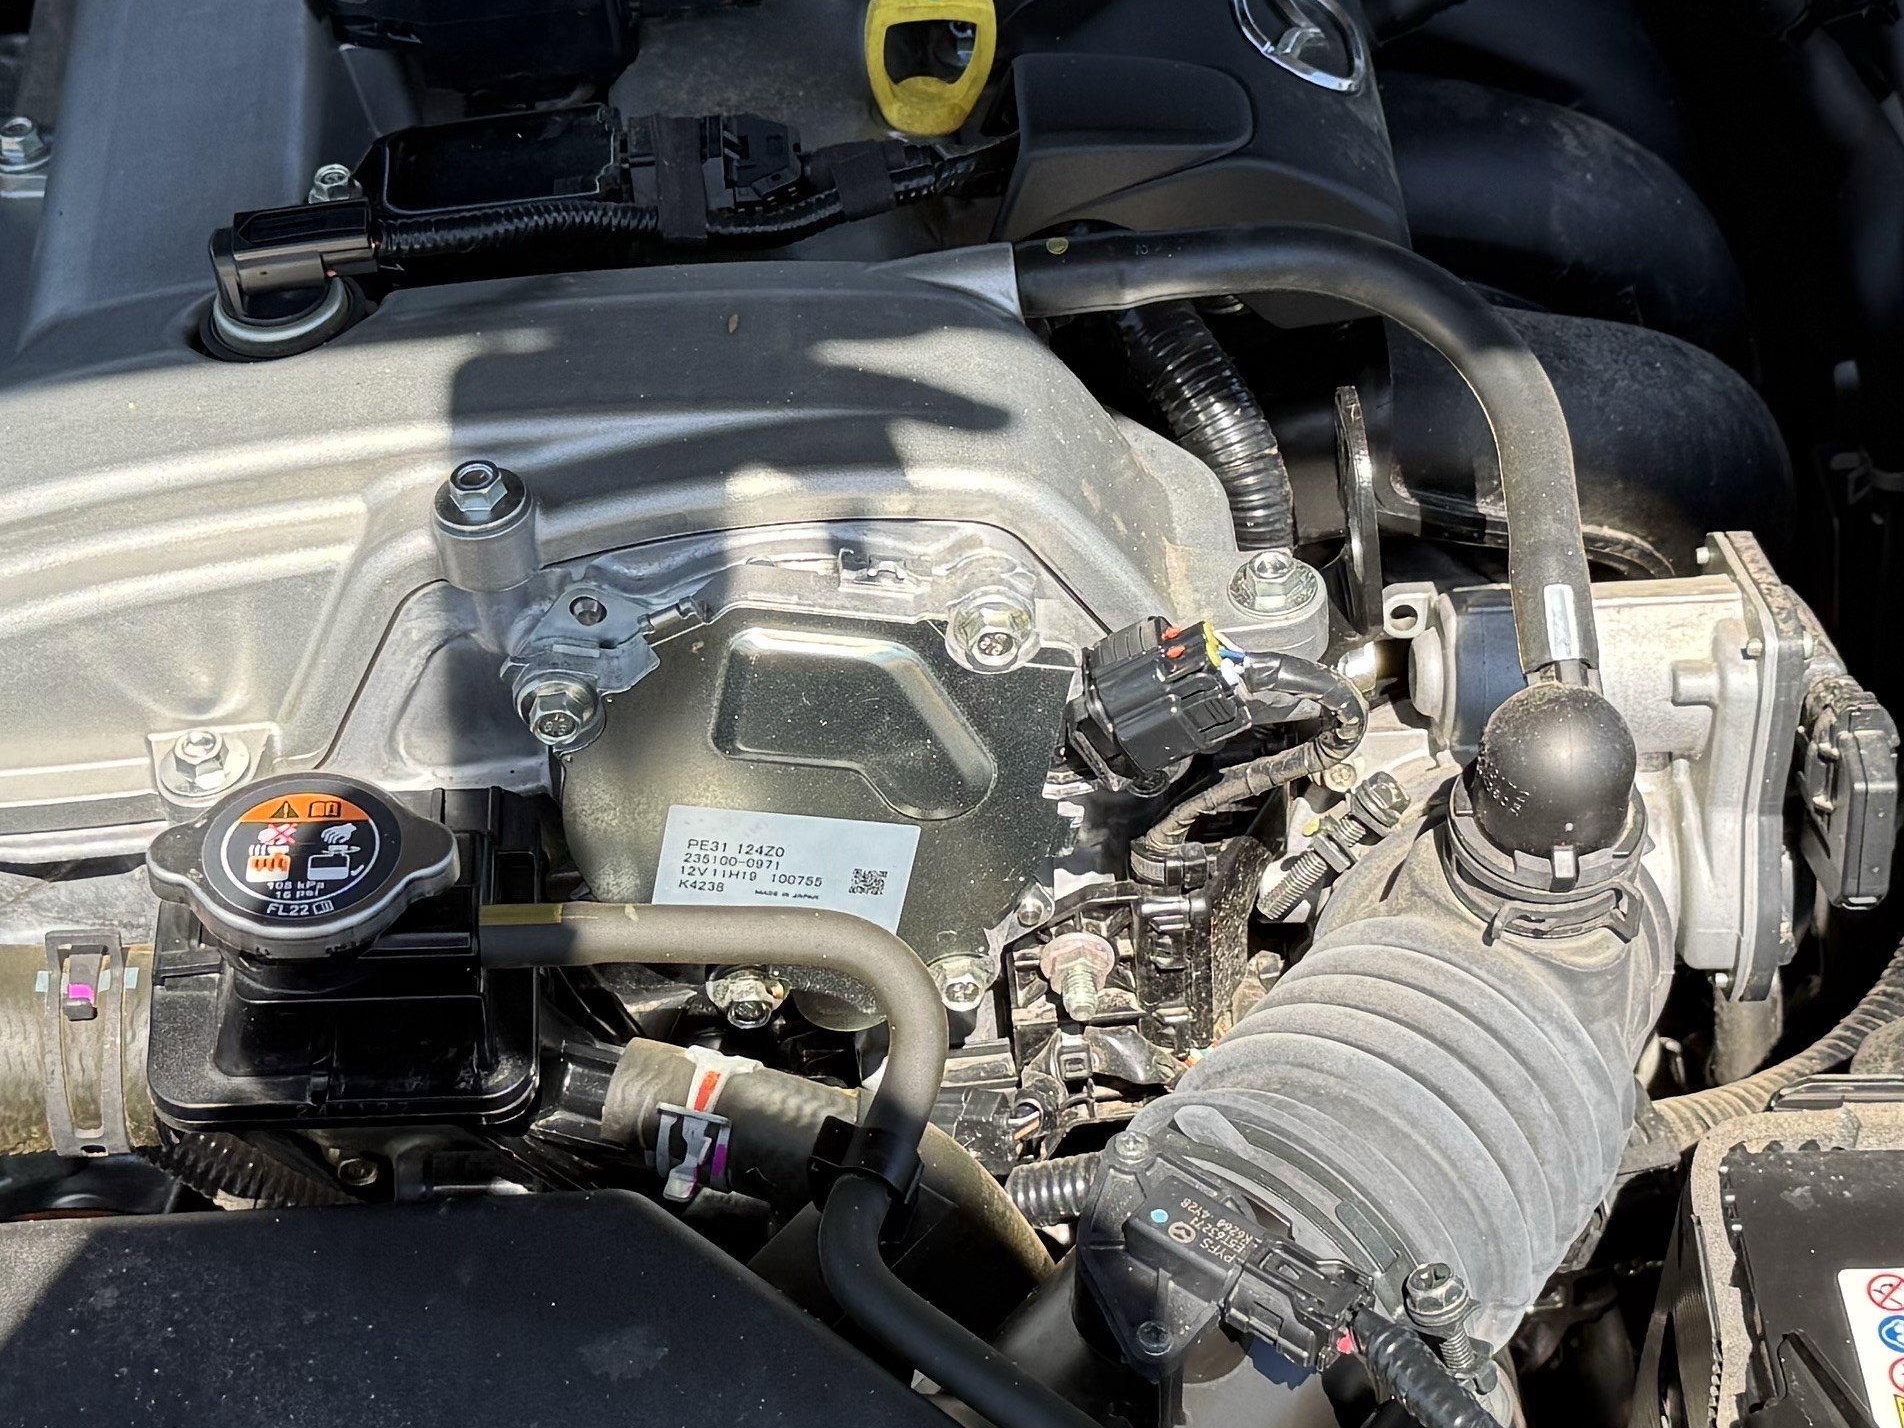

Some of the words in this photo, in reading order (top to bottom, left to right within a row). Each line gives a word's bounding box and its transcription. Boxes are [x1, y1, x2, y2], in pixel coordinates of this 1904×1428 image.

[686, 838, 727, 853] PE31
[266, 902, 310, 916] FL22
[1200, 1238, 1237, 1264] PYFS
